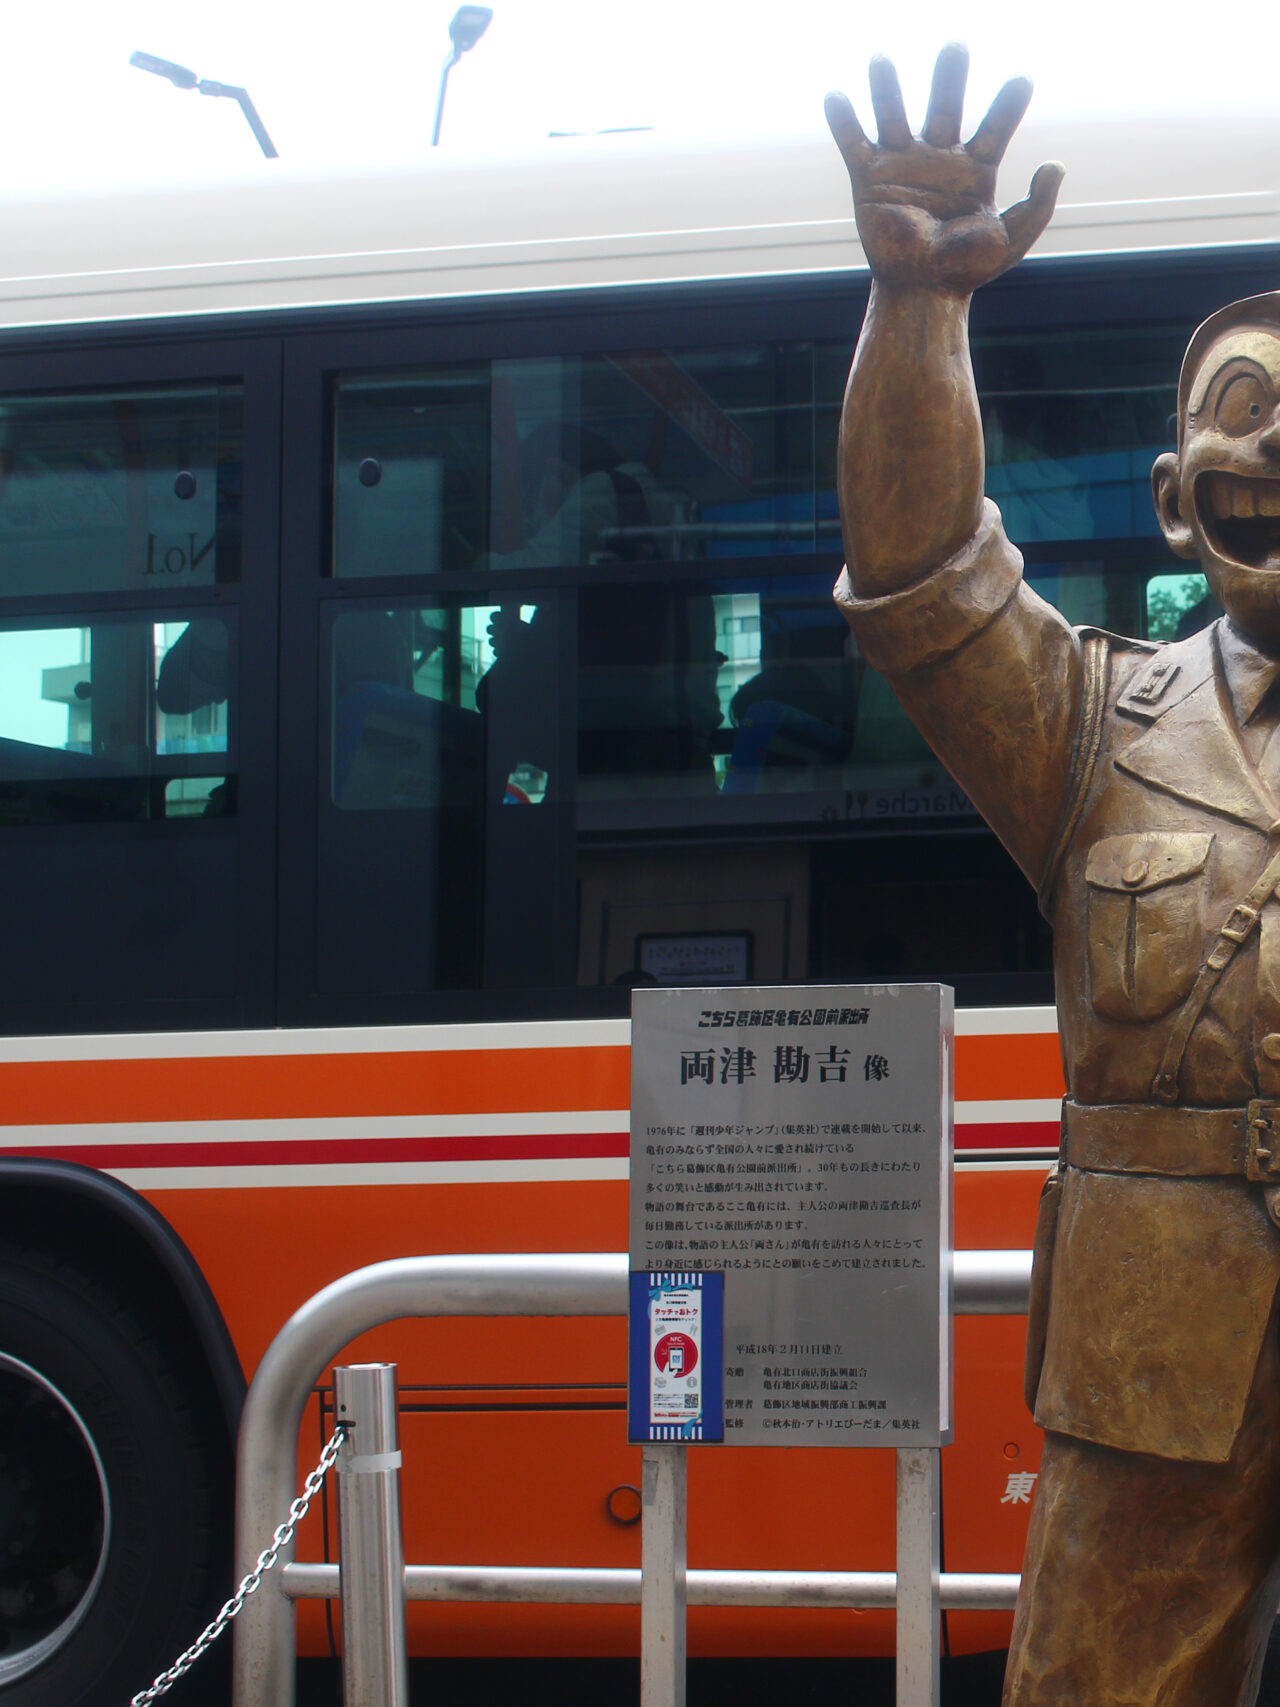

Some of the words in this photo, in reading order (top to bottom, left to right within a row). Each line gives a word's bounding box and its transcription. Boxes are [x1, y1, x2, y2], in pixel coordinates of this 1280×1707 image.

[680, 1047, 757, 1085] 両津
[773, 1045, 851, 1083] 勘吉
[863, 1054, 889, 1081] 像
[1000, 1471, 1038, 1504] 東
